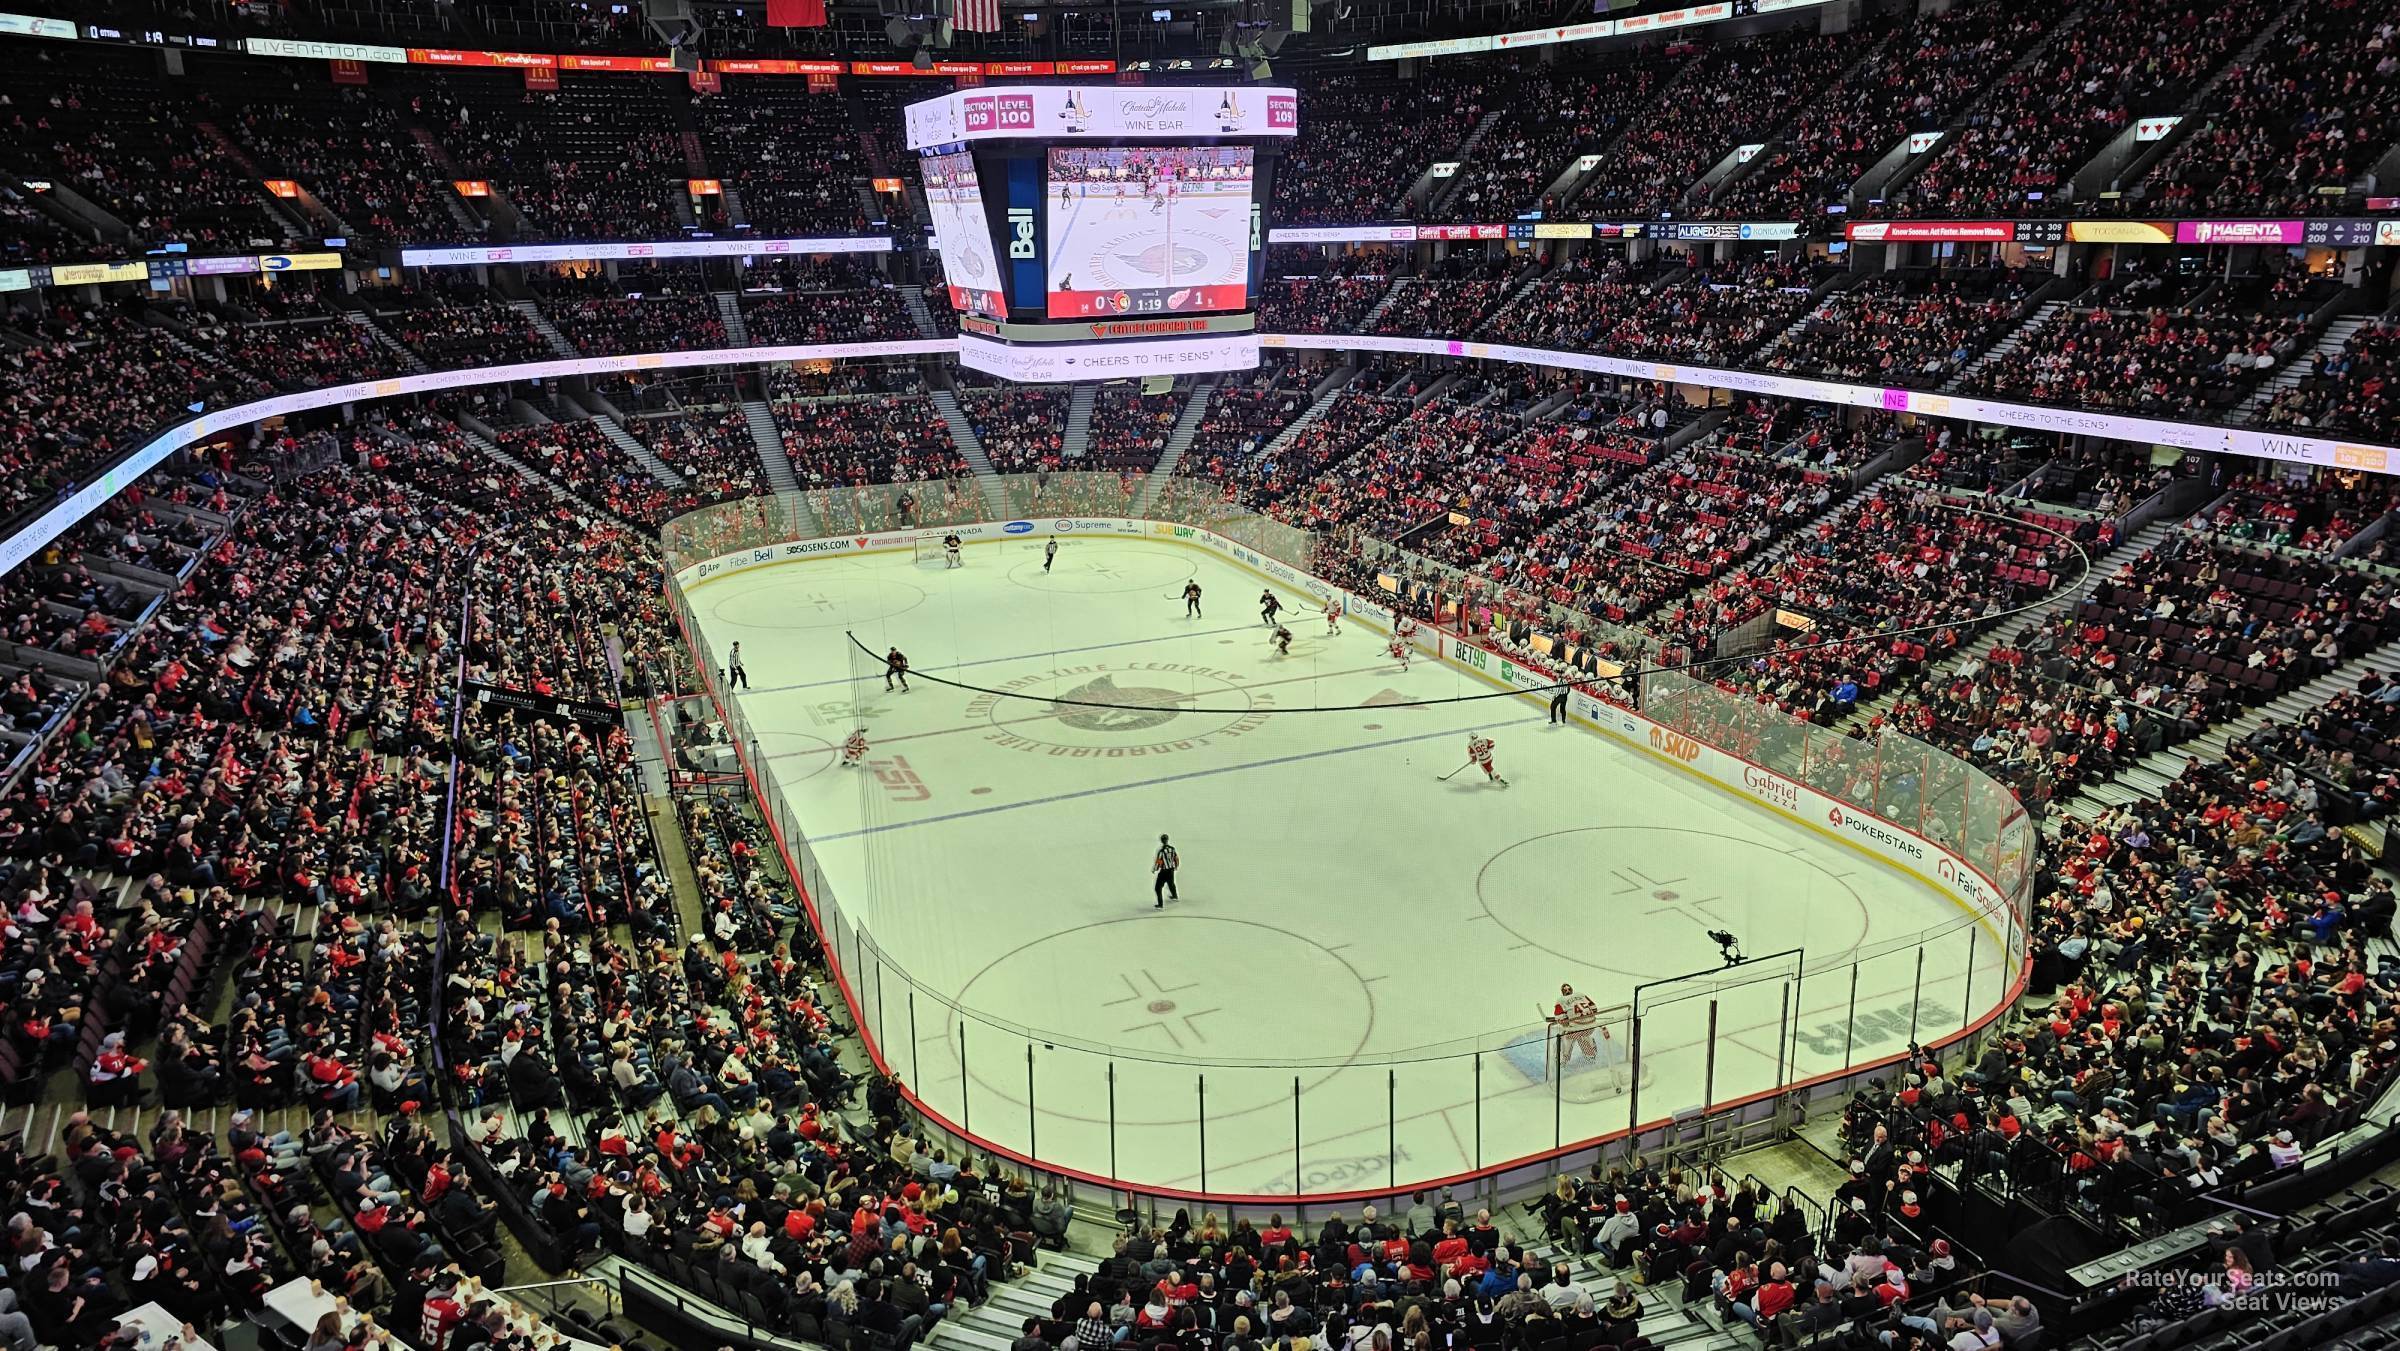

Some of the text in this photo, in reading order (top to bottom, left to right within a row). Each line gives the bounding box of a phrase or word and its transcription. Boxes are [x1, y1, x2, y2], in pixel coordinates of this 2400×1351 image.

[1000, 100, 1031, 109] LEVEL
[969, 114, 988, 125] 109
[1001, 111, 1030, 124] 100
[1275, 112, 1293, 122] 109
[1125, 120, 1183, 130] WINE BAR
[1008, 208, 1035, 258] Bell
[1478, 225, 1501, 236] Gabriel
[1892, 228, 1908, 236] Know
[1909, 228, 1929, 236] Sooner.
[2213, 224, 2283, 235] MAGENTA
[2309, 223, 2371, 231] 309 310
[2308, 234, 2370, 243] 209 210
[727, 243, 754, 251] WINE
[450, 252, 477, 260] WINE
[1096, 297, 1105, 309] 0
[1195, 292, 1202, 304] 1
[1137, 299, 1162, 310] 1:19
[598, 360, 625, 368] WINE
[1084, 355, 1129, 367] CHEERS
[1135, 354, 1148, 364] TO
[1154, 353, 1174, 363] THE
[1032, 371, 1052, 380] BAR
[1626, 364, 1647, 375] WINE
[436, 372, 487, 384] CHEERS TO THE
[1708, 374, 1756, 386] CHEERS TO THE
[343, 386, 367, 398] WINE
[1873, 392, 1905, 408] WINE
[1999, 410, 2036, 421] CHEERS
[2040, 414, 2051, 423] TO
[2055, 416, 2073, 426] THE
[2262, 438, 2313, 458] WINE
[2186, 455, 2200, 463] 107
[1075, 521, 1111, 530] Supreme
[1154, 524, 1195, 539] SUBWAY
[754, 550, 773, 562] Bell
[1455, 642, 1487, 670] BET99
[1050, 664, 1107, 678] TIRE
[1129, 662, 1229, 679] CENTRE
[1664, 733, 1700, 762] SKIP
[1744, 767, 1798, 801] Gabriel
[1759, 789, 1798, 811] PIZZA
[1845, 816, 1923, 859] POKERSTARS
[1957, 872, 2005, 928] FairSquare
